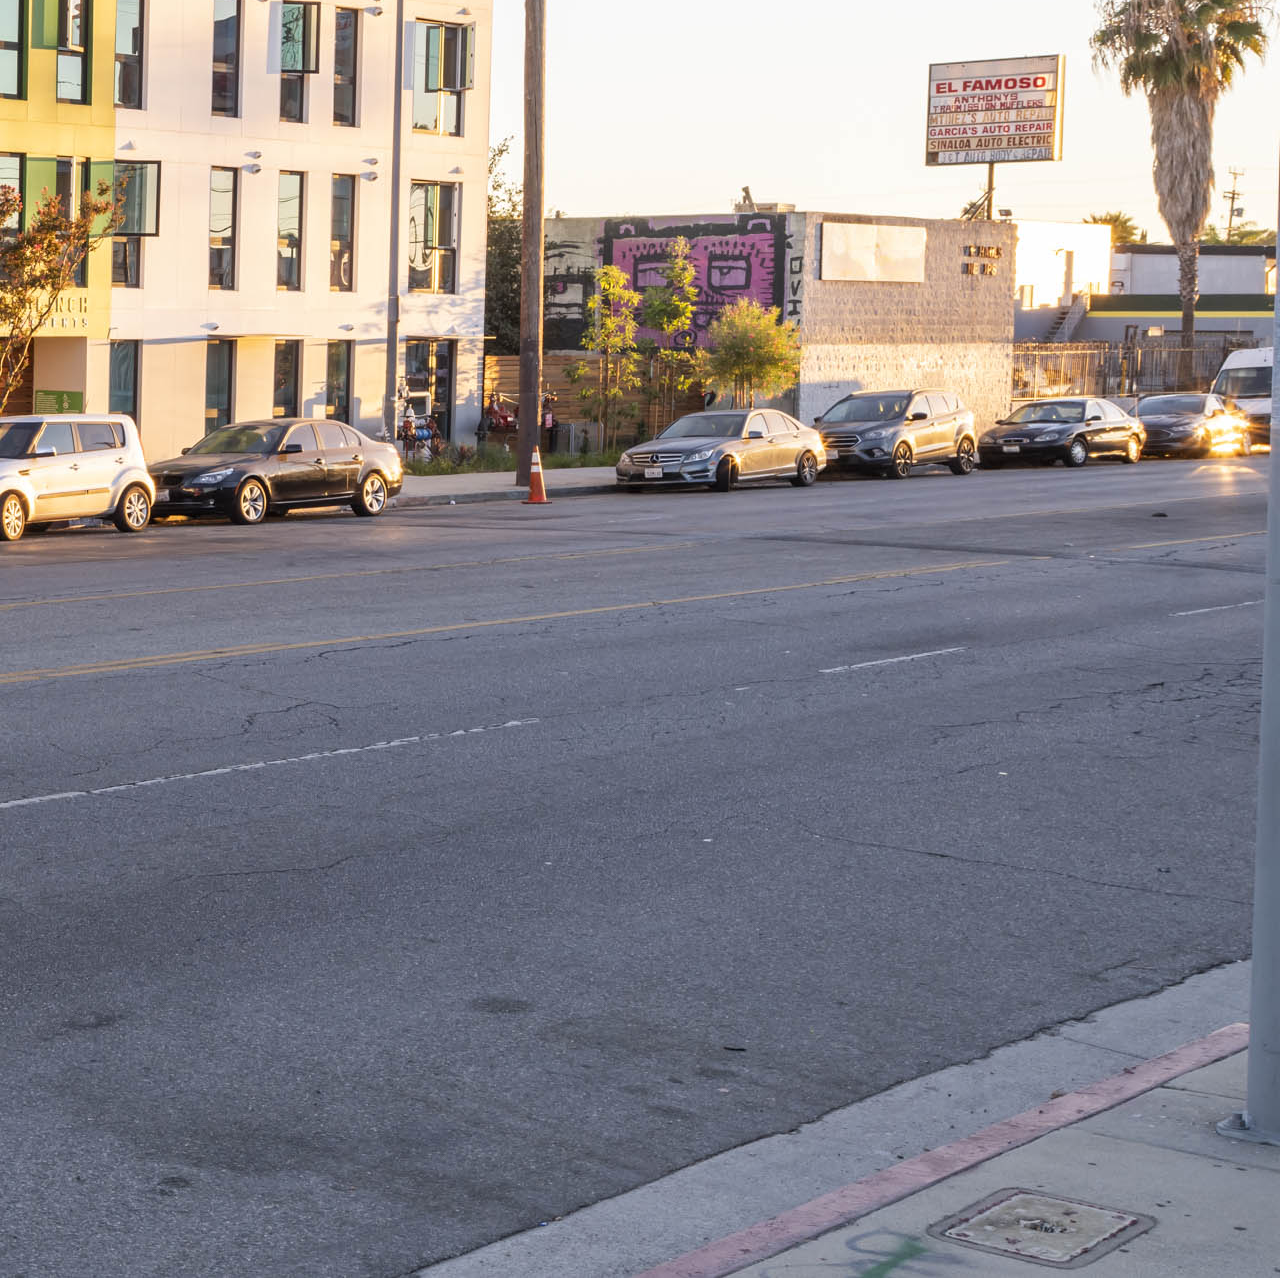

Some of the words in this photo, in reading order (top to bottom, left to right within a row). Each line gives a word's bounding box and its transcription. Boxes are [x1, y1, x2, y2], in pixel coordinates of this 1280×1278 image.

[936, 82, 958, 94] EL
[963, 76, 1046, 92] FAMOSO
[954, 93, 1017, 104] ANTHONYS
[982, 110, 1010, 123] AUTO
[929, 126, 978, 138] GARCIA'S
[982, 124, 1011, 135] AUTO
[1015, 122, 1053, 133] REPAIR
[930, 138, 972, 150] SINALOA
[975, 136, 1003, 148] AUTO
[1006, 134, 1052, 147] ELECTRIC
